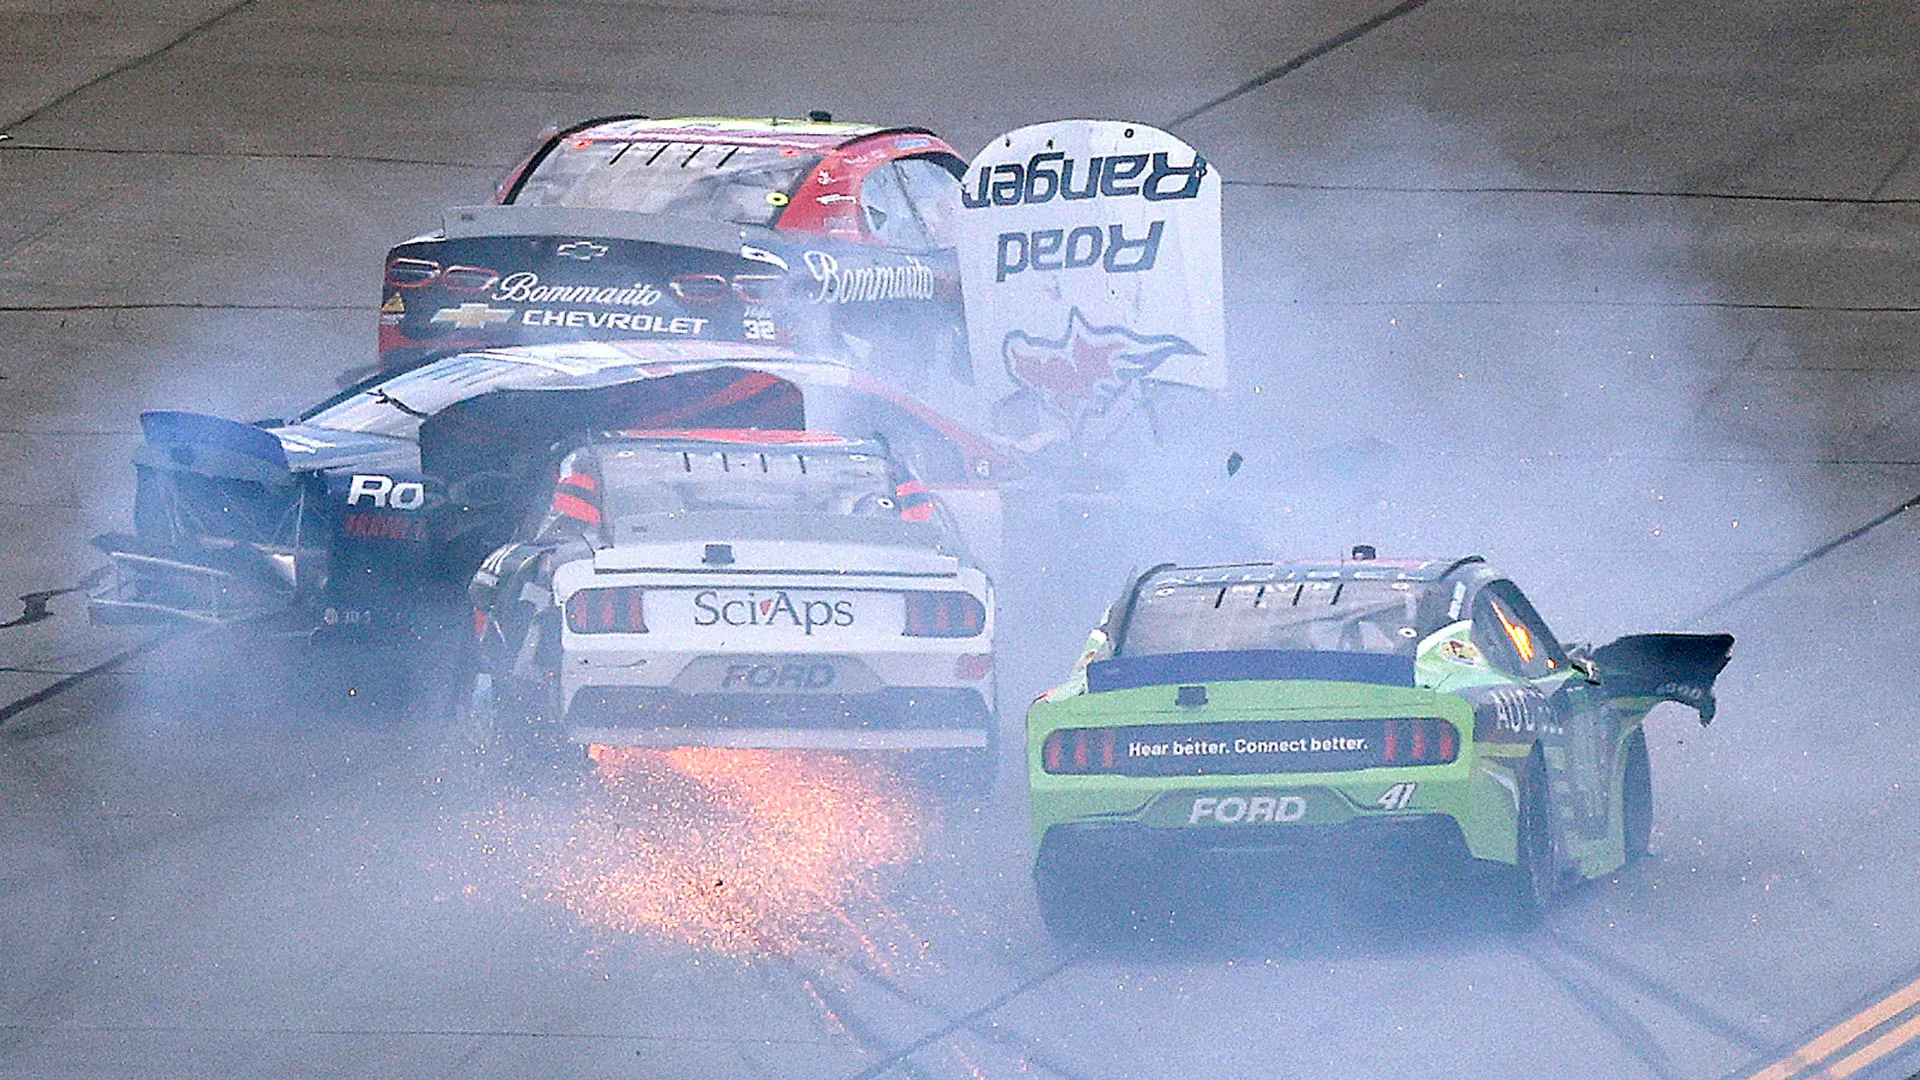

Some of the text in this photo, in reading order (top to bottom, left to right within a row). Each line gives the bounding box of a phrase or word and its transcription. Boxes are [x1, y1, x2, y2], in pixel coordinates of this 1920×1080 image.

[961, 152, 1207, 209] Ranger
[996, 221, 1165, 282] Road
[491, 272, 662, 307] Bommarito
[522, 309, 710, 335] CHEVROLET
[743, 319, 776, 340] 32
[694, 590, 854, 635] SciAps
[722, 663, 836, 688] FORD
[1129, 736, 1368, 757] Hear better. Connect better.
[1189, 796, 1307, 824] FORD
[1377, 782, 1417, 810] 41
